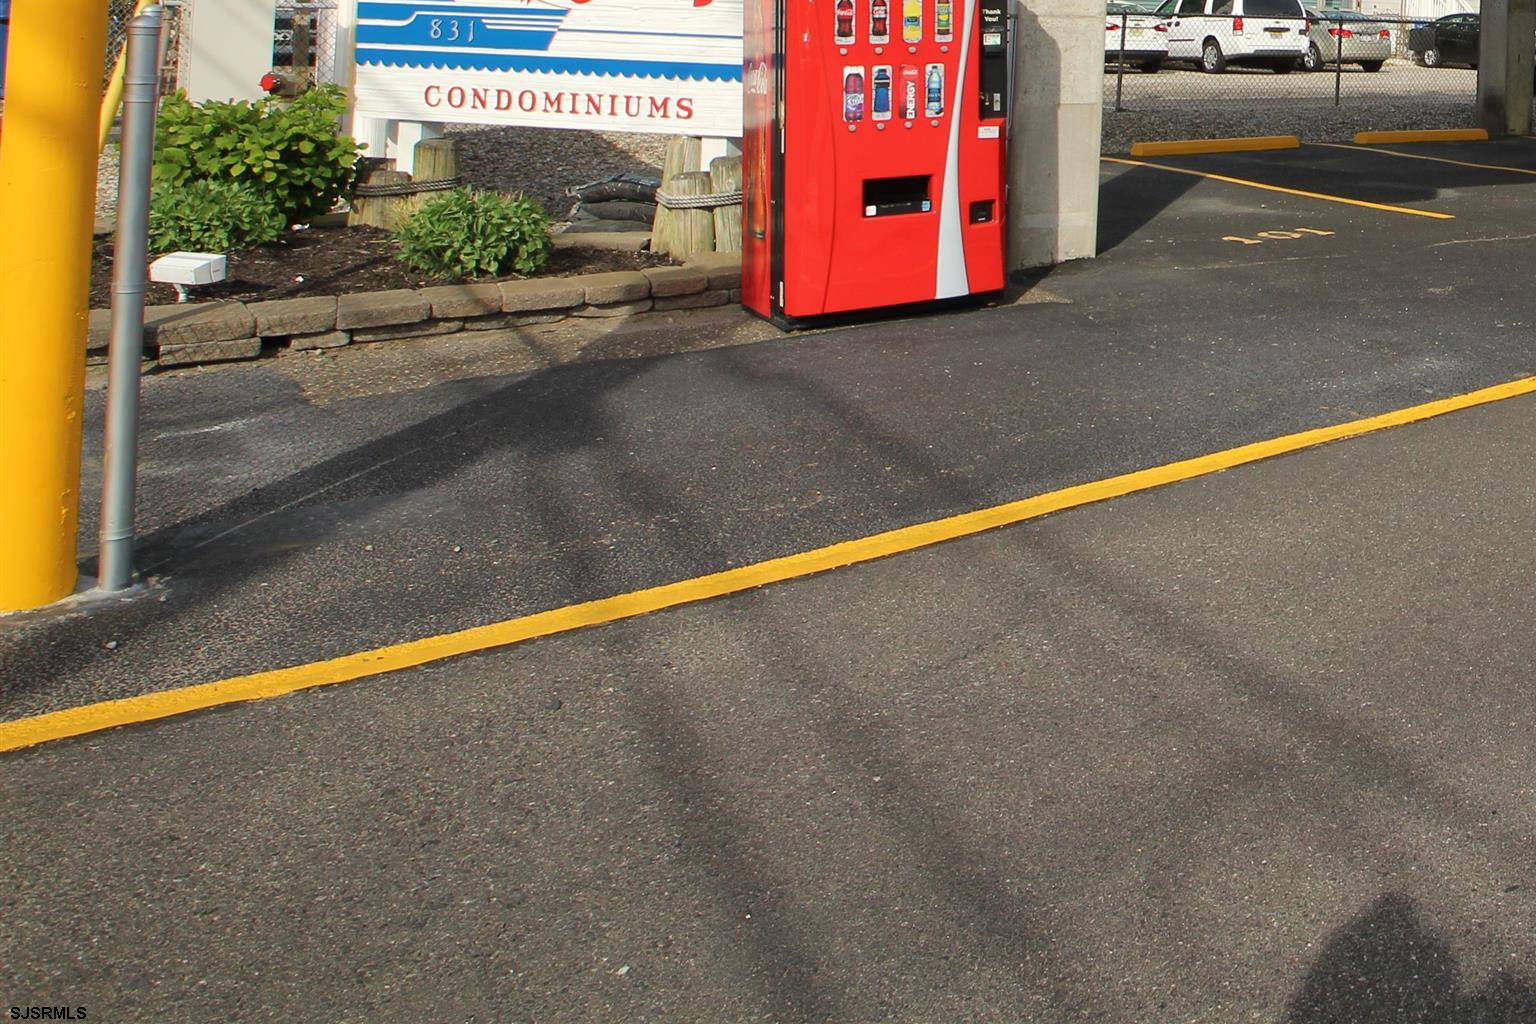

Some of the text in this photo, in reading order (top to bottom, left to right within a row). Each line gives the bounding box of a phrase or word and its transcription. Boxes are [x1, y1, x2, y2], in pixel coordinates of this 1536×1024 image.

[430, 18, 475, 43] 831
[423, 85, 695, 121] CONDOMINIUMS
[906, 80, 915, 119] ENERGY
[1221, 226, 1336, 246] 101
